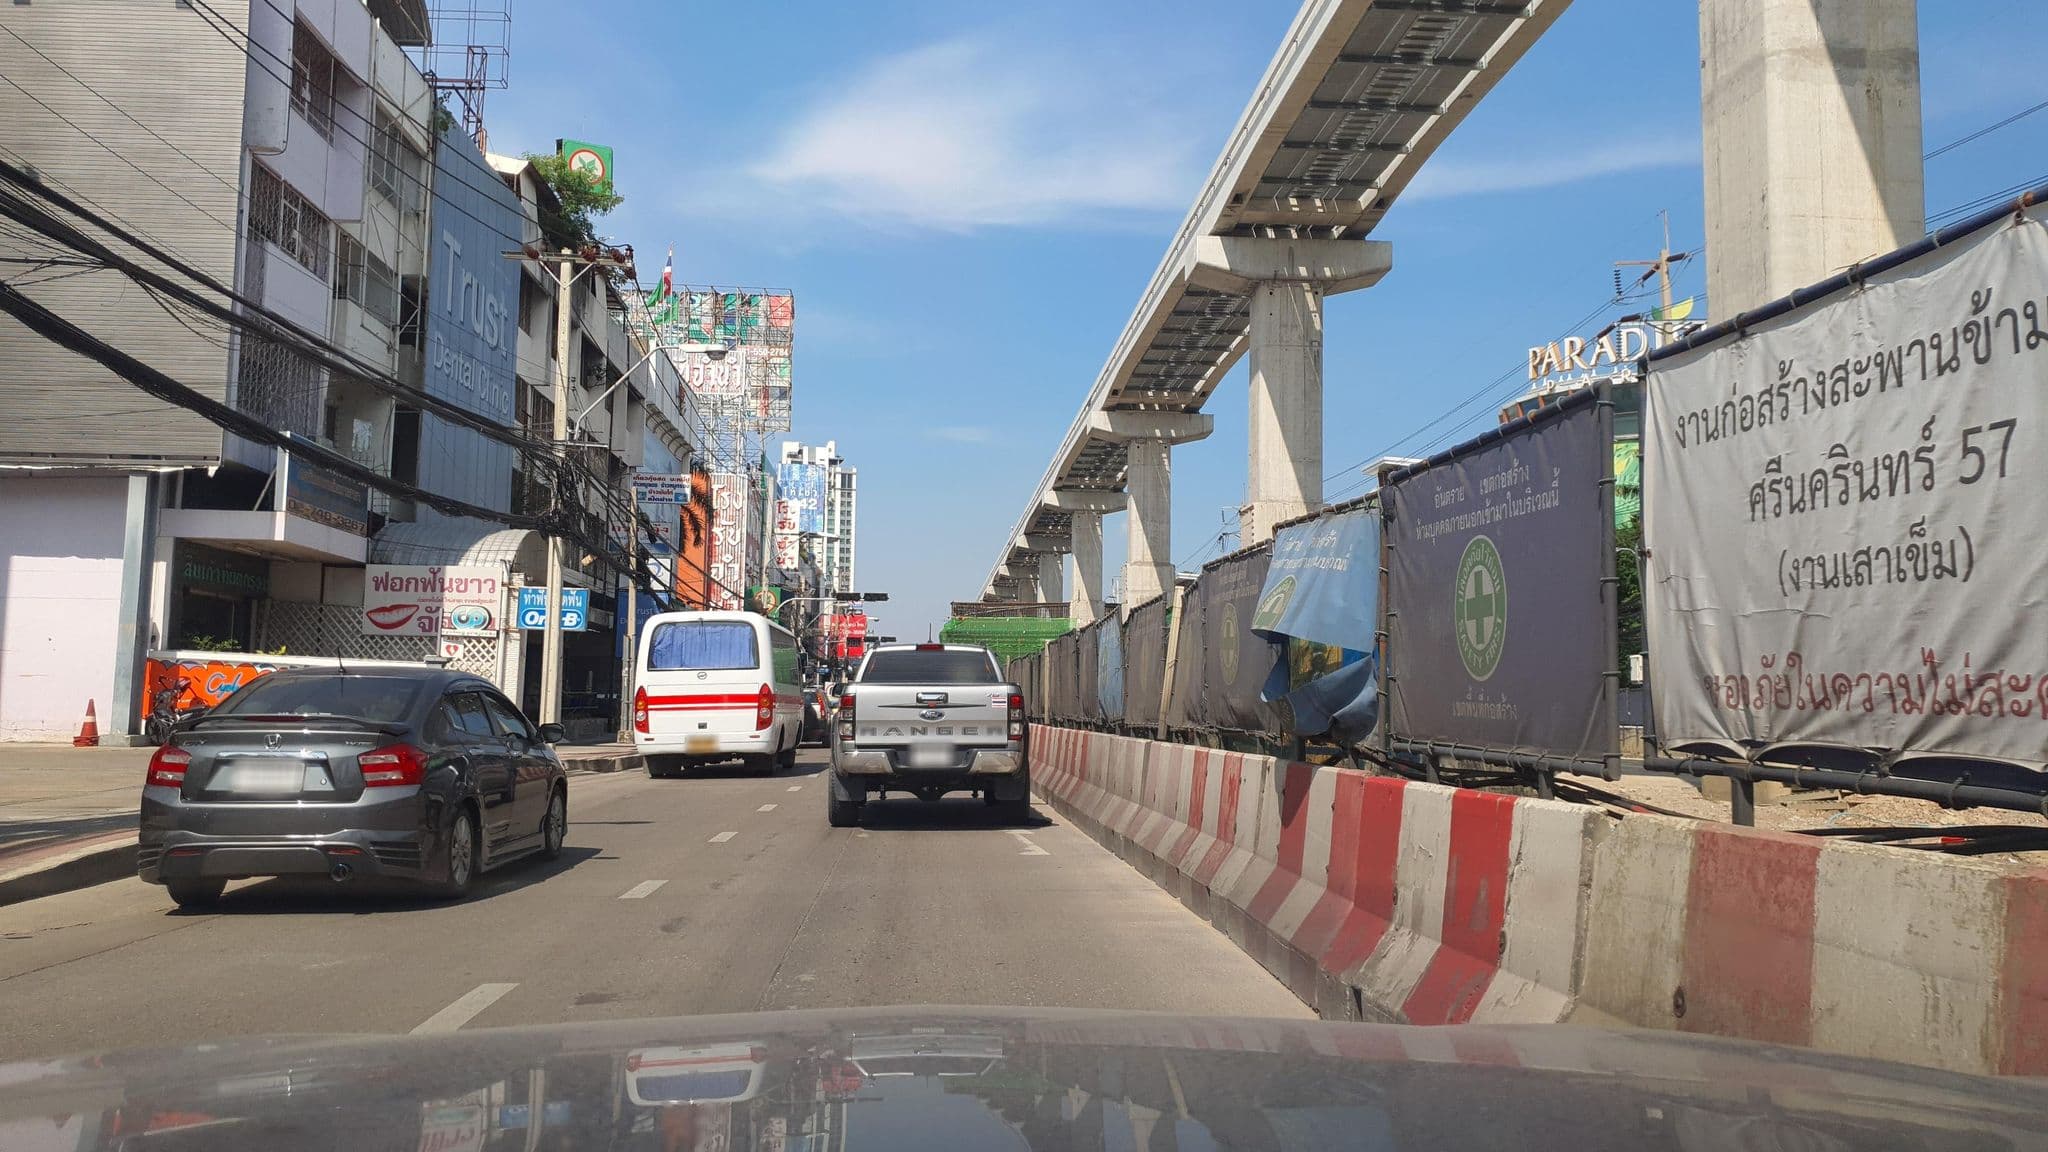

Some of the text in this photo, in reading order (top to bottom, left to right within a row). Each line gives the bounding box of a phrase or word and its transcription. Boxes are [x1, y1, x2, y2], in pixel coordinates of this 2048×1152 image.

[443, 230, 508, 360] Trust
[433, 331, 509, 415] Dental Clinic
[1528, 322, 1706, 381] PARADI
[1675, 287, 2048, 449] งานก่อสร้างสะพานข้าม
[1480, 458, 1530, 496] เขตก่อสร้าง
[1750, 415, 2018, 522] ศรีนครินทร์ 57
[372, 567, 496, 594] ฟอกฟันขาว
[1779, 515, 1975, 597] (งานเสาเข็ม)
[524, 588, 548, 606] ทำฟั
[525, 611, 578, 627] Or-B
[860, 726, 1003, 737] RANGER
